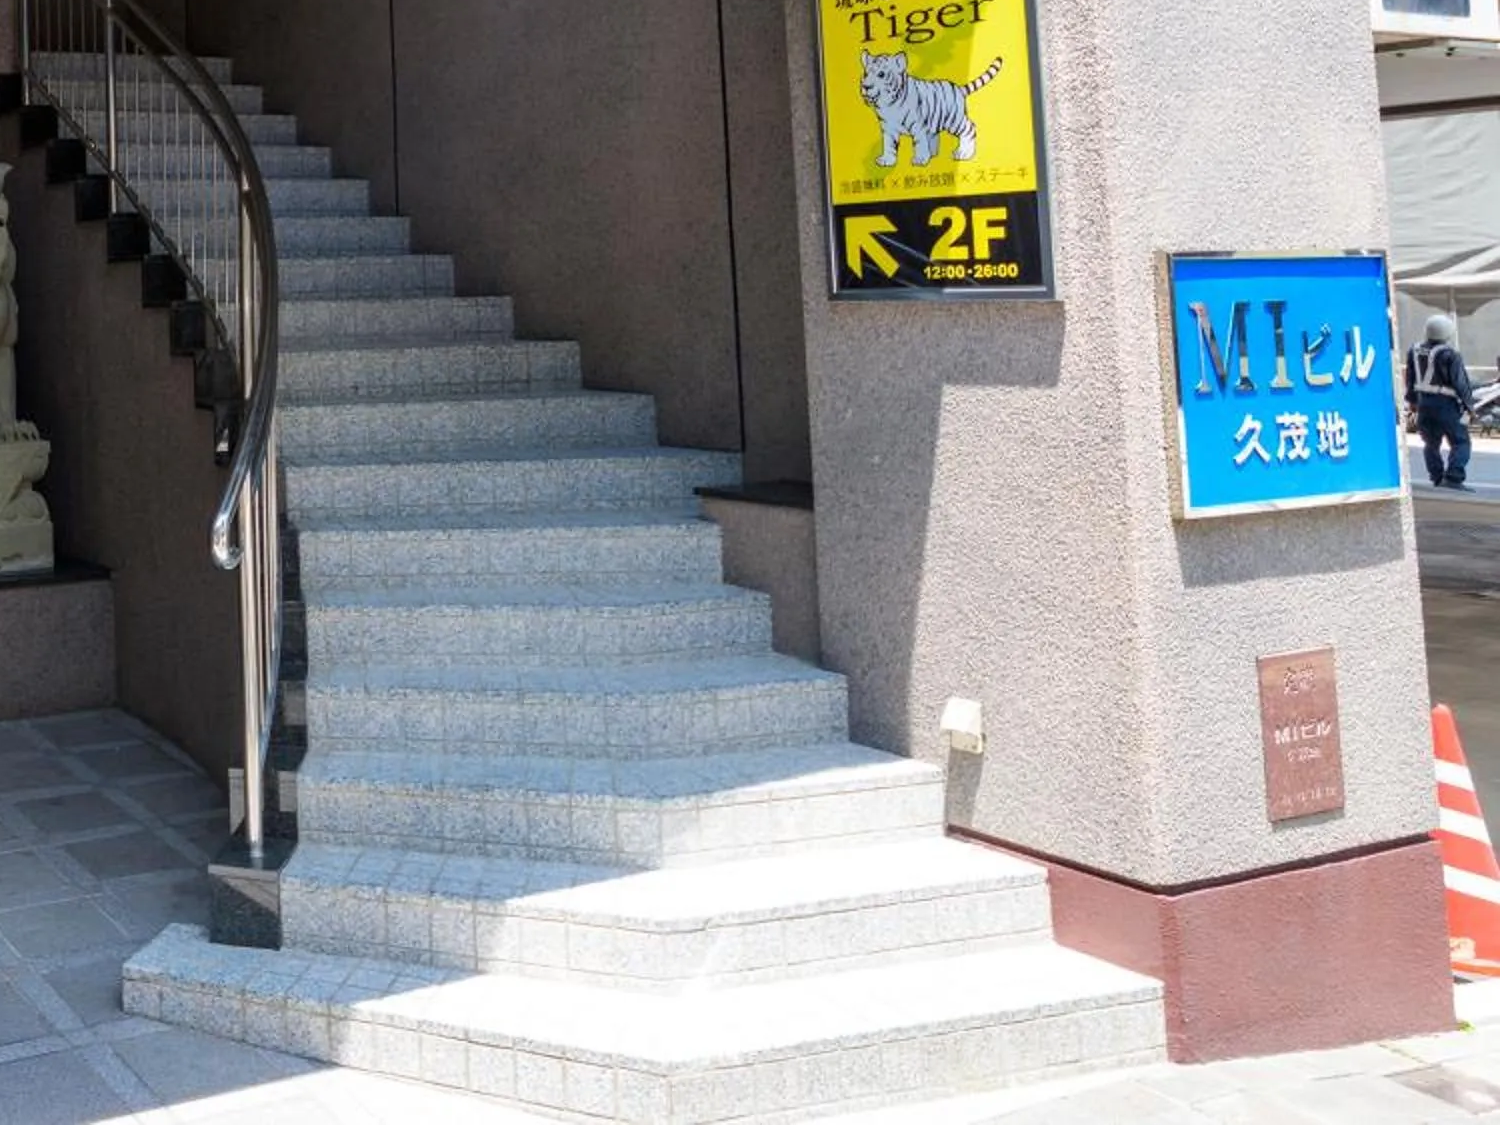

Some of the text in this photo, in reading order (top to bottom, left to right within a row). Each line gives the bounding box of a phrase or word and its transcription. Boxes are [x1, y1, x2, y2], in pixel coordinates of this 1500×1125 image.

[927, 205, 1008, 261] 2F
[1233, 410, 1349, 466] 久茂地
